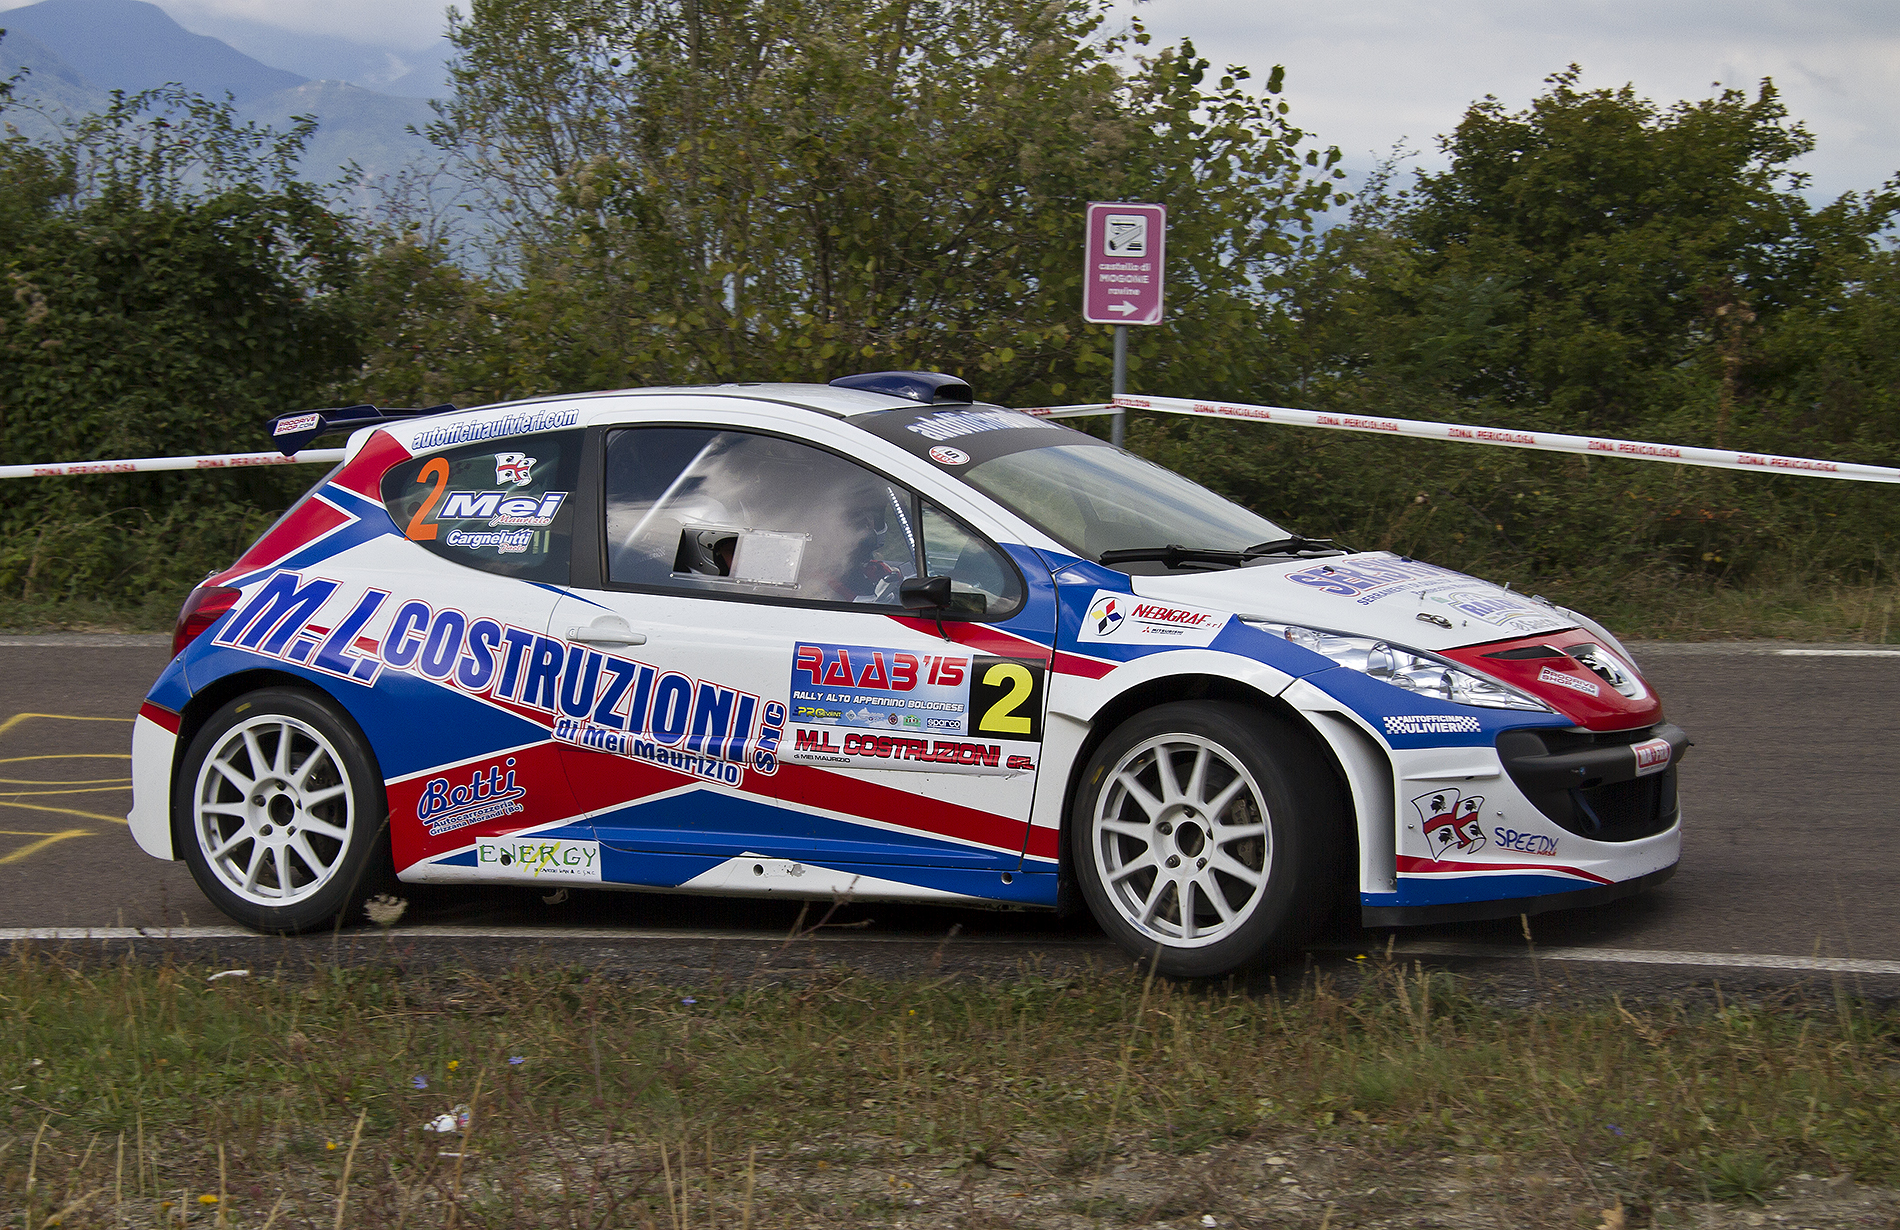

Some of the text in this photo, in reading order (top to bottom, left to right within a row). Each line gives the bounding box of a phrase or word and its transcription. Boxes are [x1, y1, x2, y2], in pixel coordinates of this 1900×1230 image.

[1098, 263, 1151, 271] castello di
[279, 416, 316, 427] PRODRIVE
[1193, 404, 1271, 419] ZONA PERICOLOSA
[412, 409, 579, 450] autofficinaulivieri.com
[1317, 415, 1399, 431] ZONA PERICOLOSA
[1448, 428, 1535, 444] ZONA PERICOLOSA
[1588, 440, 1681, 458] ZONA PERICOLOSA
[404, 457, 450, 541] 2
[436, 491, 567, 520] Mei
[489, 514, 554, 527] Maurizio
[448, 529, 534, 548] Cargnelutti
[1131, 604, 1211, 625] NEBIGRAF
[380, 599, 759, 764] COSTRUZIONI
[1543, 669, 1596, 690] PRODRIVE
[793, 690, 965, 712] RALLY ALTO APPENNINO BOLOGNESE
[978, 663, 1033, 734] 2
[926, 718, 961, 730] sparco
[1403, 715, 1461, 723] AUTOFFICINA
[1406, 722, 1460, 733] ULIVIERI
[754, 701, 786, 776] SNC
[555, 719, 740, 784] di Mei Maurizio
[814, 755, 851, 763] MAURIZIO
[844, 733, 1001, 766] COSTRUZIONI
[1006, 755, 1035, 771] SRL
[417, 757, 526, 819] Betti
[430, 821, 468, 836] Grizzana
[469, 810, 504, 825] Morandi
[433, 800, 515, 828] Autocarrozzeria
[1494, 827, 1559, 852] SPEEDY
[479, 843, 597, 867] ENERGY
